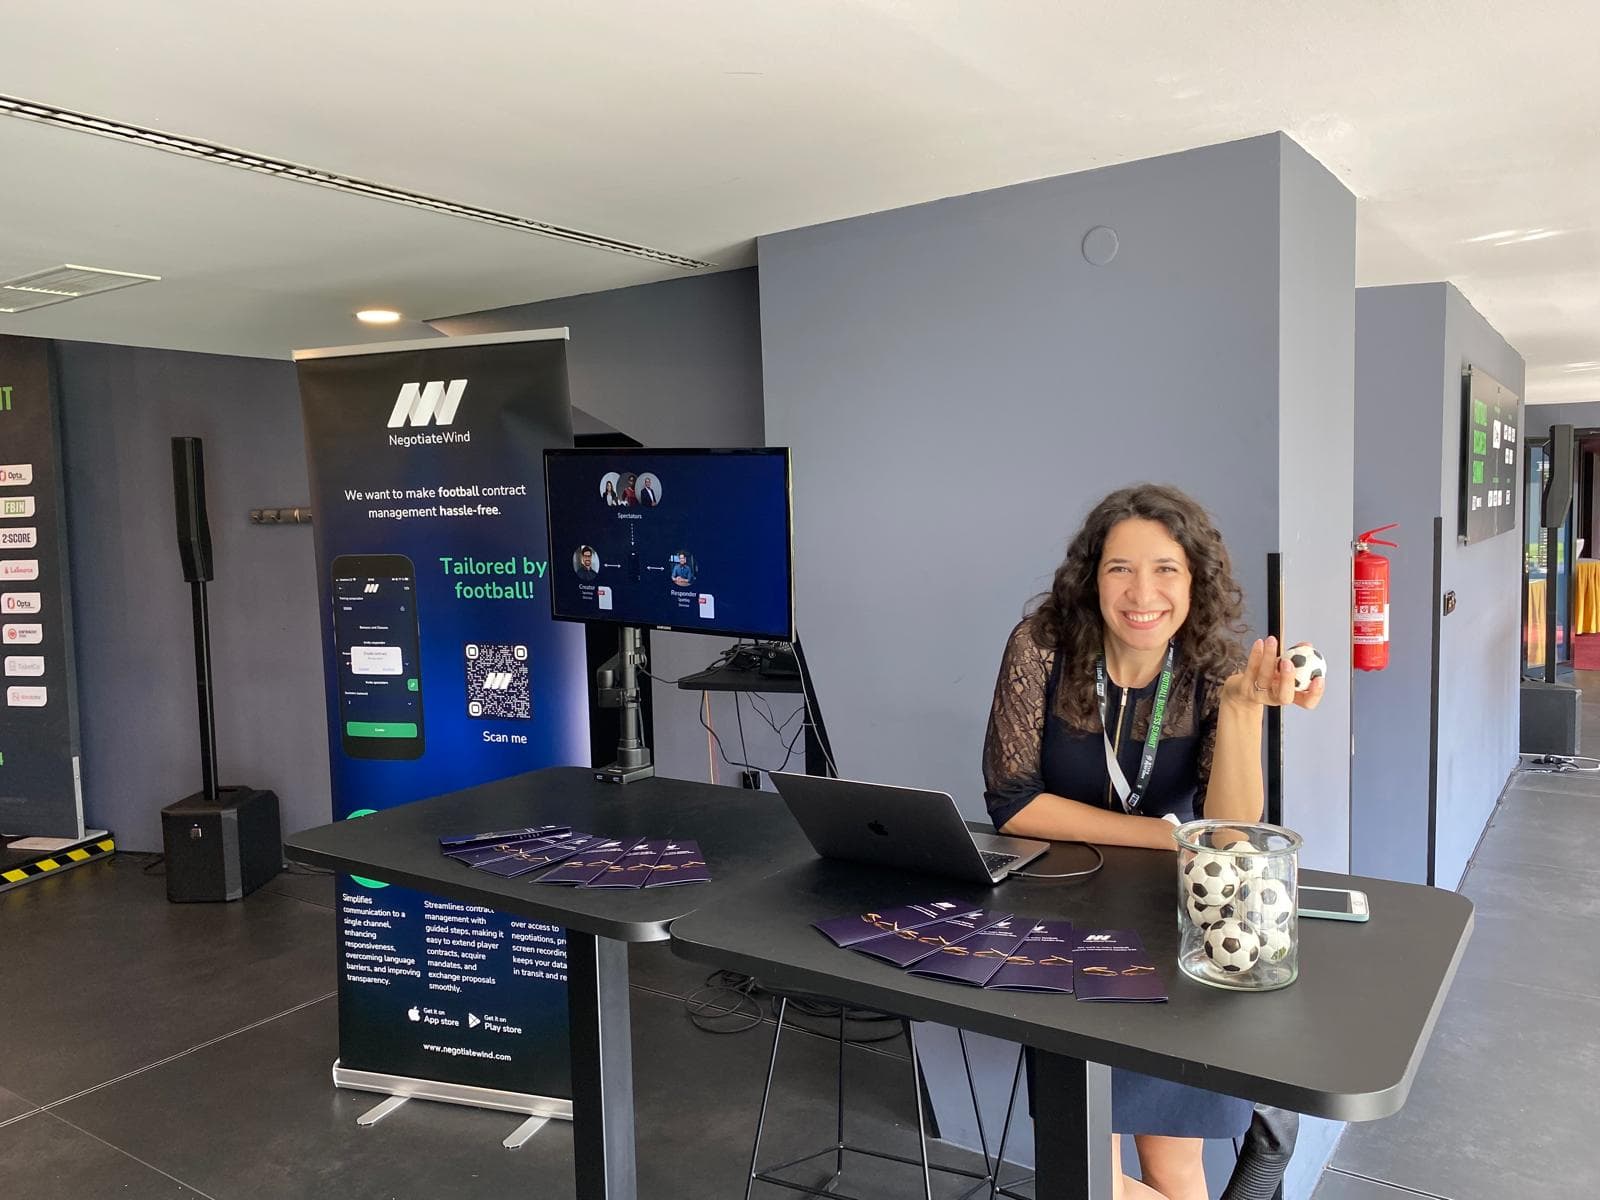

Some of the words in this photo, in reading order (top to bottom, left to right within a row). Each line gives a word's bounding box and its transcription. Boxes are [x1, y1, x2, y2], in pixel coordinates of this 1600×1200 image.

[389, 431, 470, 447] NegotiateWind
[8, 472, 22, 480] Opta
[344, 490, 362, 501] We
[365, 489, 390, 500] want
[392, 488, 403, 500] to
[405, 486, 436, 499] make
[438, 486, 480, 497] football
[482, 484, 526, 496] contract
[368, 507, 437, 520] management
[439, 504, 501, 516] hassle-free.
[440, 557, 516, 575] Tailored
[523, 557, 547, 578] by
[455, 581, 534, 599] football!
[17, 600, 30, 608] Opta
[483, 731, 508, 743] Scan
[511, 733, 528, 744] me
[342, 893, 372, 904] Simplifies
[424, 900, 464, 911] Streamlines
[343, 907, 391, 916] communication
[344, 917, 362, 926] single
[425, 913, 469, 923] management
[528, 923, 550, 931] access
[344, 929, 377, 940] enhancing
[450, 927, 470, 936] steps,
[472, 929, 497, 939] making
[499, 930, 504, 938] it
[512, 933, 556, 944] negotiations,
[345, 941, 396, 952] responsiveness,
[452, 939, 475, 947] extend
[477, 941, 499, 950] player
[512, 945, 535, 953] screen
[346, 952, 382, 962] overcoming
[384, 955, 415, 965] language
[427, 949, 459, 958] contracts,
[461, 952, 486, 960] acquire
[428, 960, 462, 969] mandates,
[513, 955, 533, 965] keeps
[552, 961, 568, 969] data
[346, 962, 372, 972] barriers,
[388, 966, 420, 978] improving
[521, 969, 544, 978] transit
[347, 974, 391, 986] transparency.
[428, 971, 460, 981] exchange
[462, 975, 496, 985] proposals
[429, 983, 462, 993] smoothly.
[424, 1015, 439, 1025] App
[441, 1018, 459, 1027] store
[484, 1022, 500, 1033] Play
[503, 1026, 522, 1034] store
[423, 1044, 512, 1061] www.negotiatewind.com
